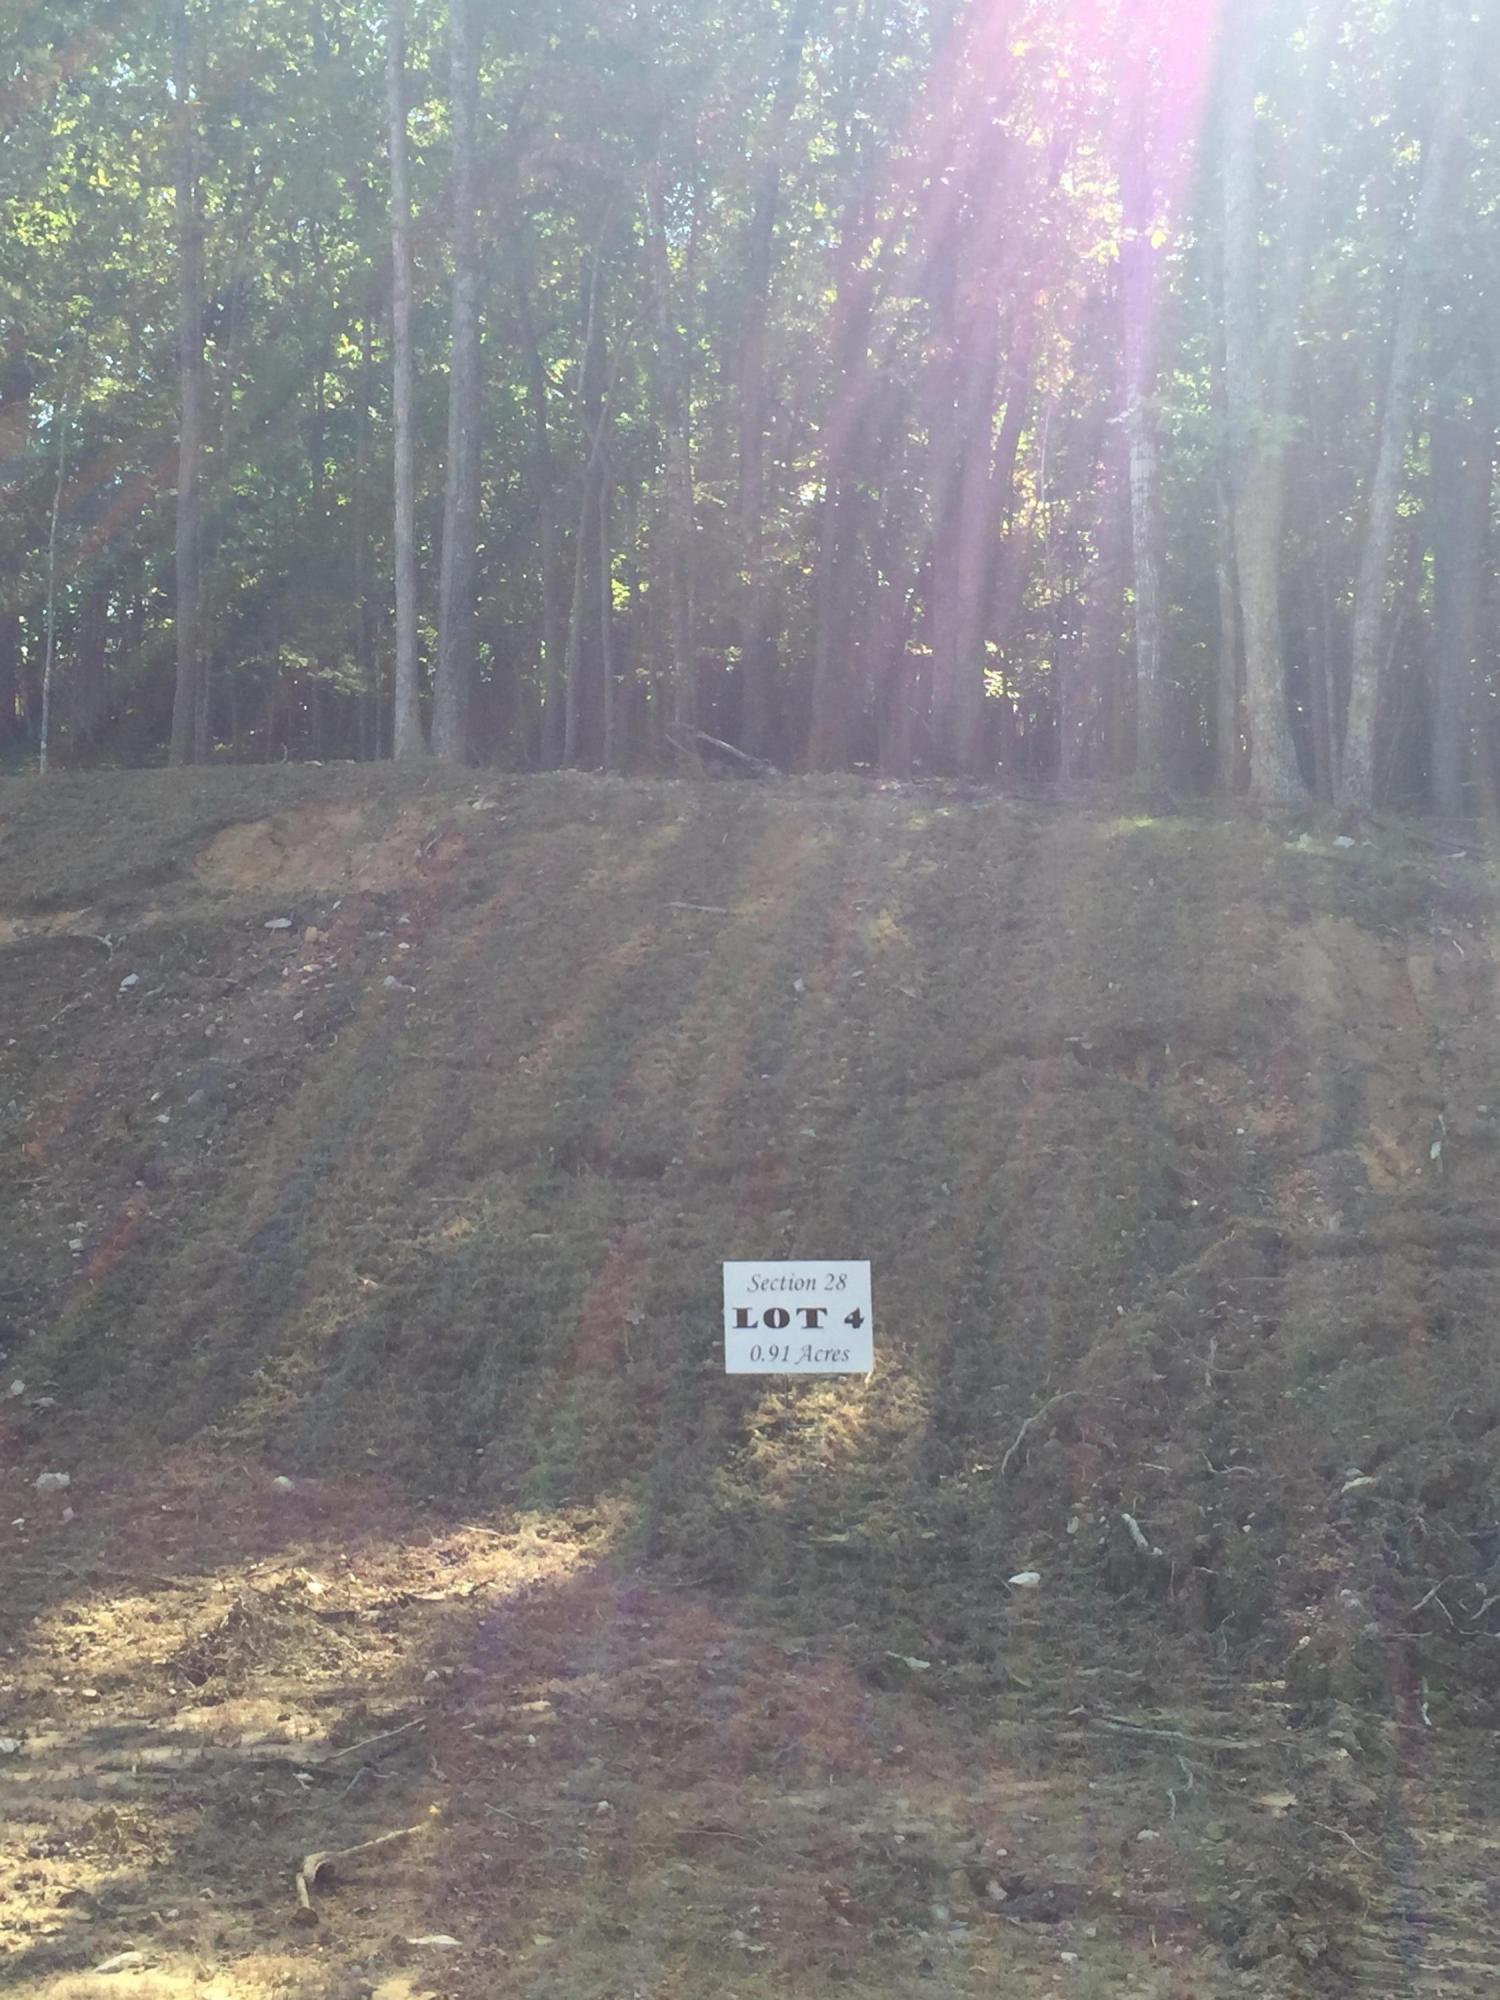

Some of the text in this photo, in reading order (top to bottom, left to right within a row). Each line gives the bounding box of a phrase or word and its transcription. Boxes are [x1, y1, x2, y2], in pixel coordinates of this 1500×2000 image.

[747, 1273, 848, 1292] Section 28
[732, 1306, 865, 1329] LOT 4
[750, 1344, 850, 1365] 0.91 Acres
